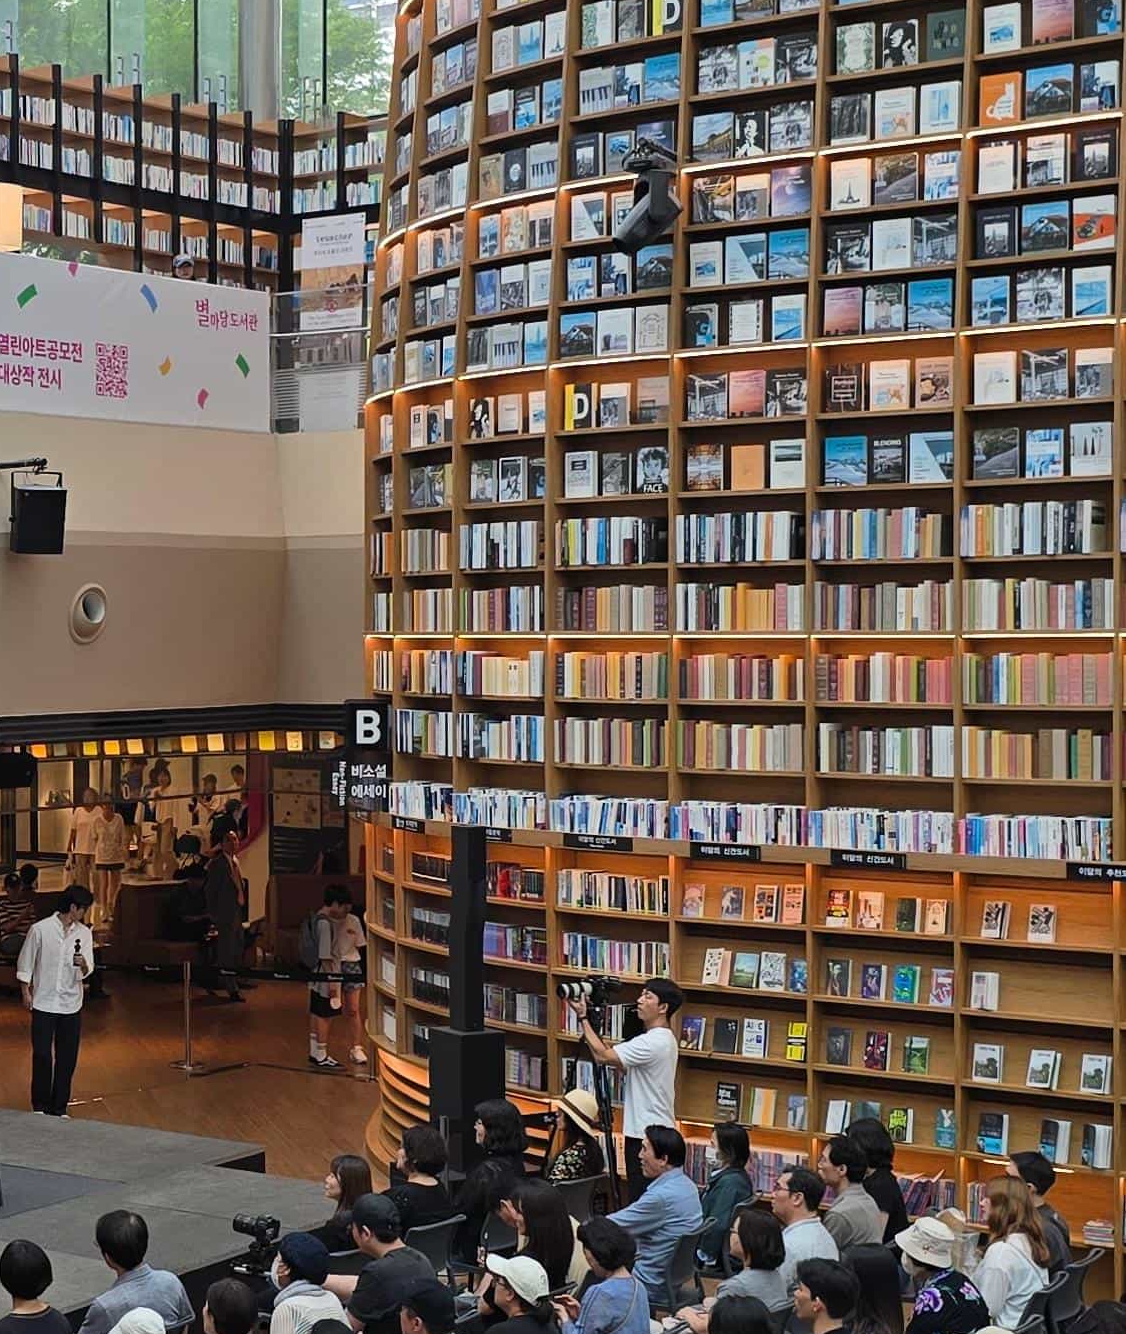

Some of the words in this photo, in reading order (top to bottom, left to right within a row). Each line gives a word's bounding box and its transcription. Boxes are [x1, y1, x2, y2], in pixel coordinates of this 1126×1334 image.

[195, 298, 259, 331] 별마당도서관
[37, 369, 62, 390] 전시
[643, 483, 664, 493] FACE
[356, 710, 381, 744] B
[351, 764, 387, 778] 비소설
[351, 784, 387, 798] 에세이
